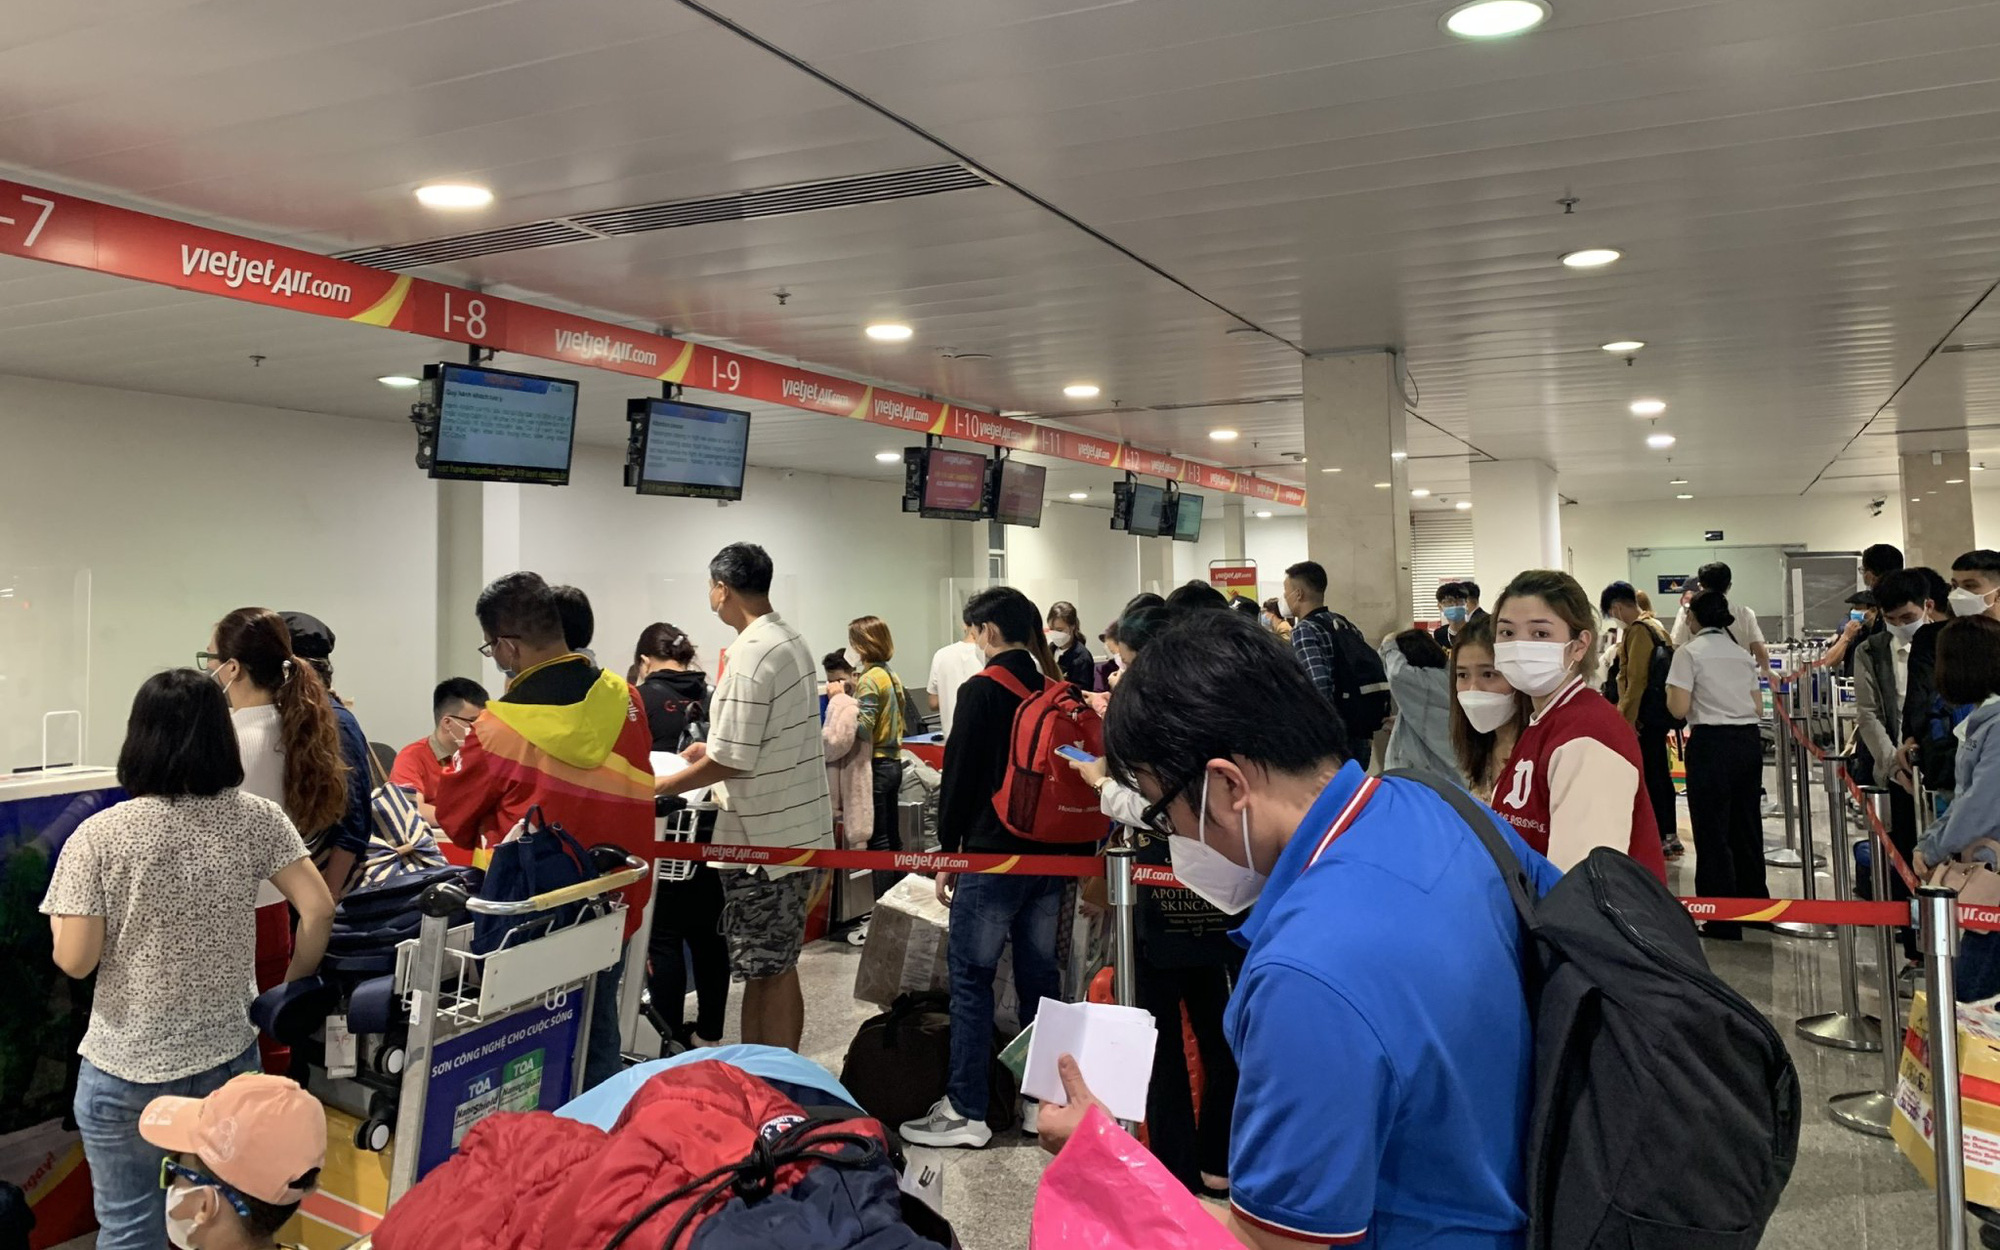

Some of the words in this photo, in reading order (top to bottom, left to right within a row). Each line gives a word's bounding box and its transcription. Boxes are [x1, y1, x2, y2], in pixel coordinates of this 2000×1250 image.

[444, 292, 487, 339] I-8
[712, 355, 741, 391] I-9
[955, 409, 979, 438] I-10
[1131, 866, 1174, 881] Air.com
[507, 1029, 526, 1045] CHO
[513, 1057, 534, 1077] TOA
[468, 1077, 491, 1098] TOA
